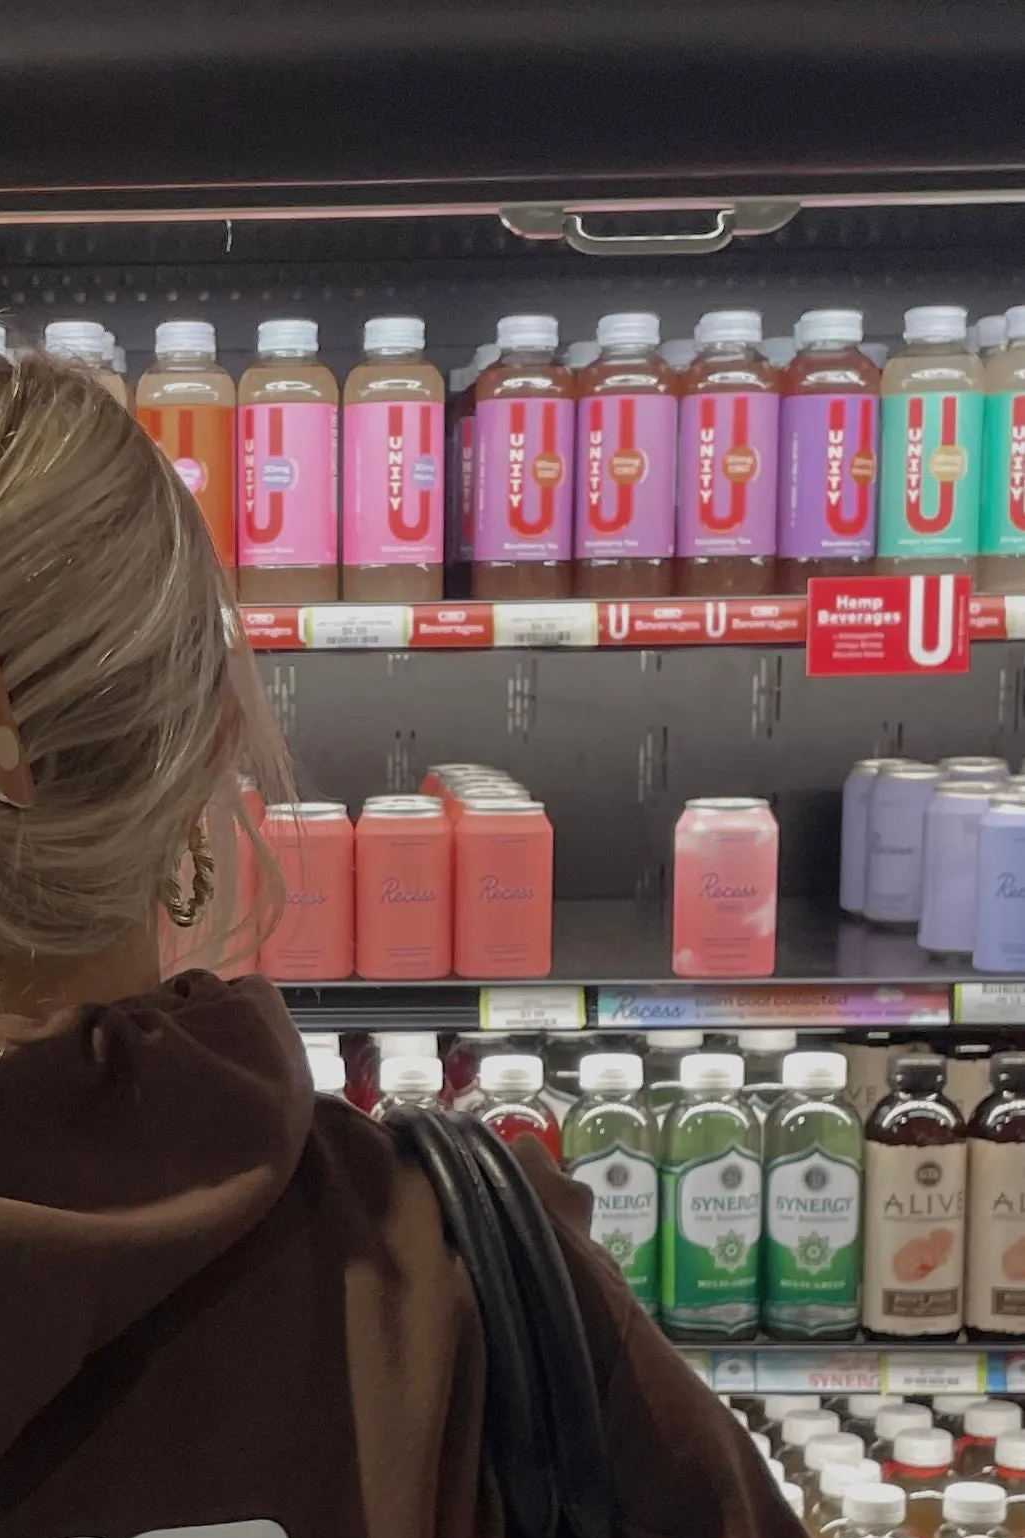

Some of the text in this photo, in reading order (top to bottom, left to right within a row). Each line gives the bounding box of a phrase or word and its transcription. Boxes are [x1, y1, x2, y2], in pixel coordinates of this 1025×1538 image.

[388, 436, 403, 511] UNITY
[509, 433, 524, 508] UNITY
[589, 430, 602, 505] UNITY
[700, 429, 714, 503] UNITY
[827, 429, 843, 505] UNITY
[907, 428, 922, 504] UNITY
[835, 594, 884, 611] Hemp
[817, 609, 902, 627] Beverages
[380, 876, 438, 904] Recess
[478, 873, 535, 901] Recess
[698, 871, 759, 899] Recess
[995, 871, 1025, 900] Rec
[596, 1191, 654, 1210] NERGY
[775, 1195, 854, 1214] SYNERGY
